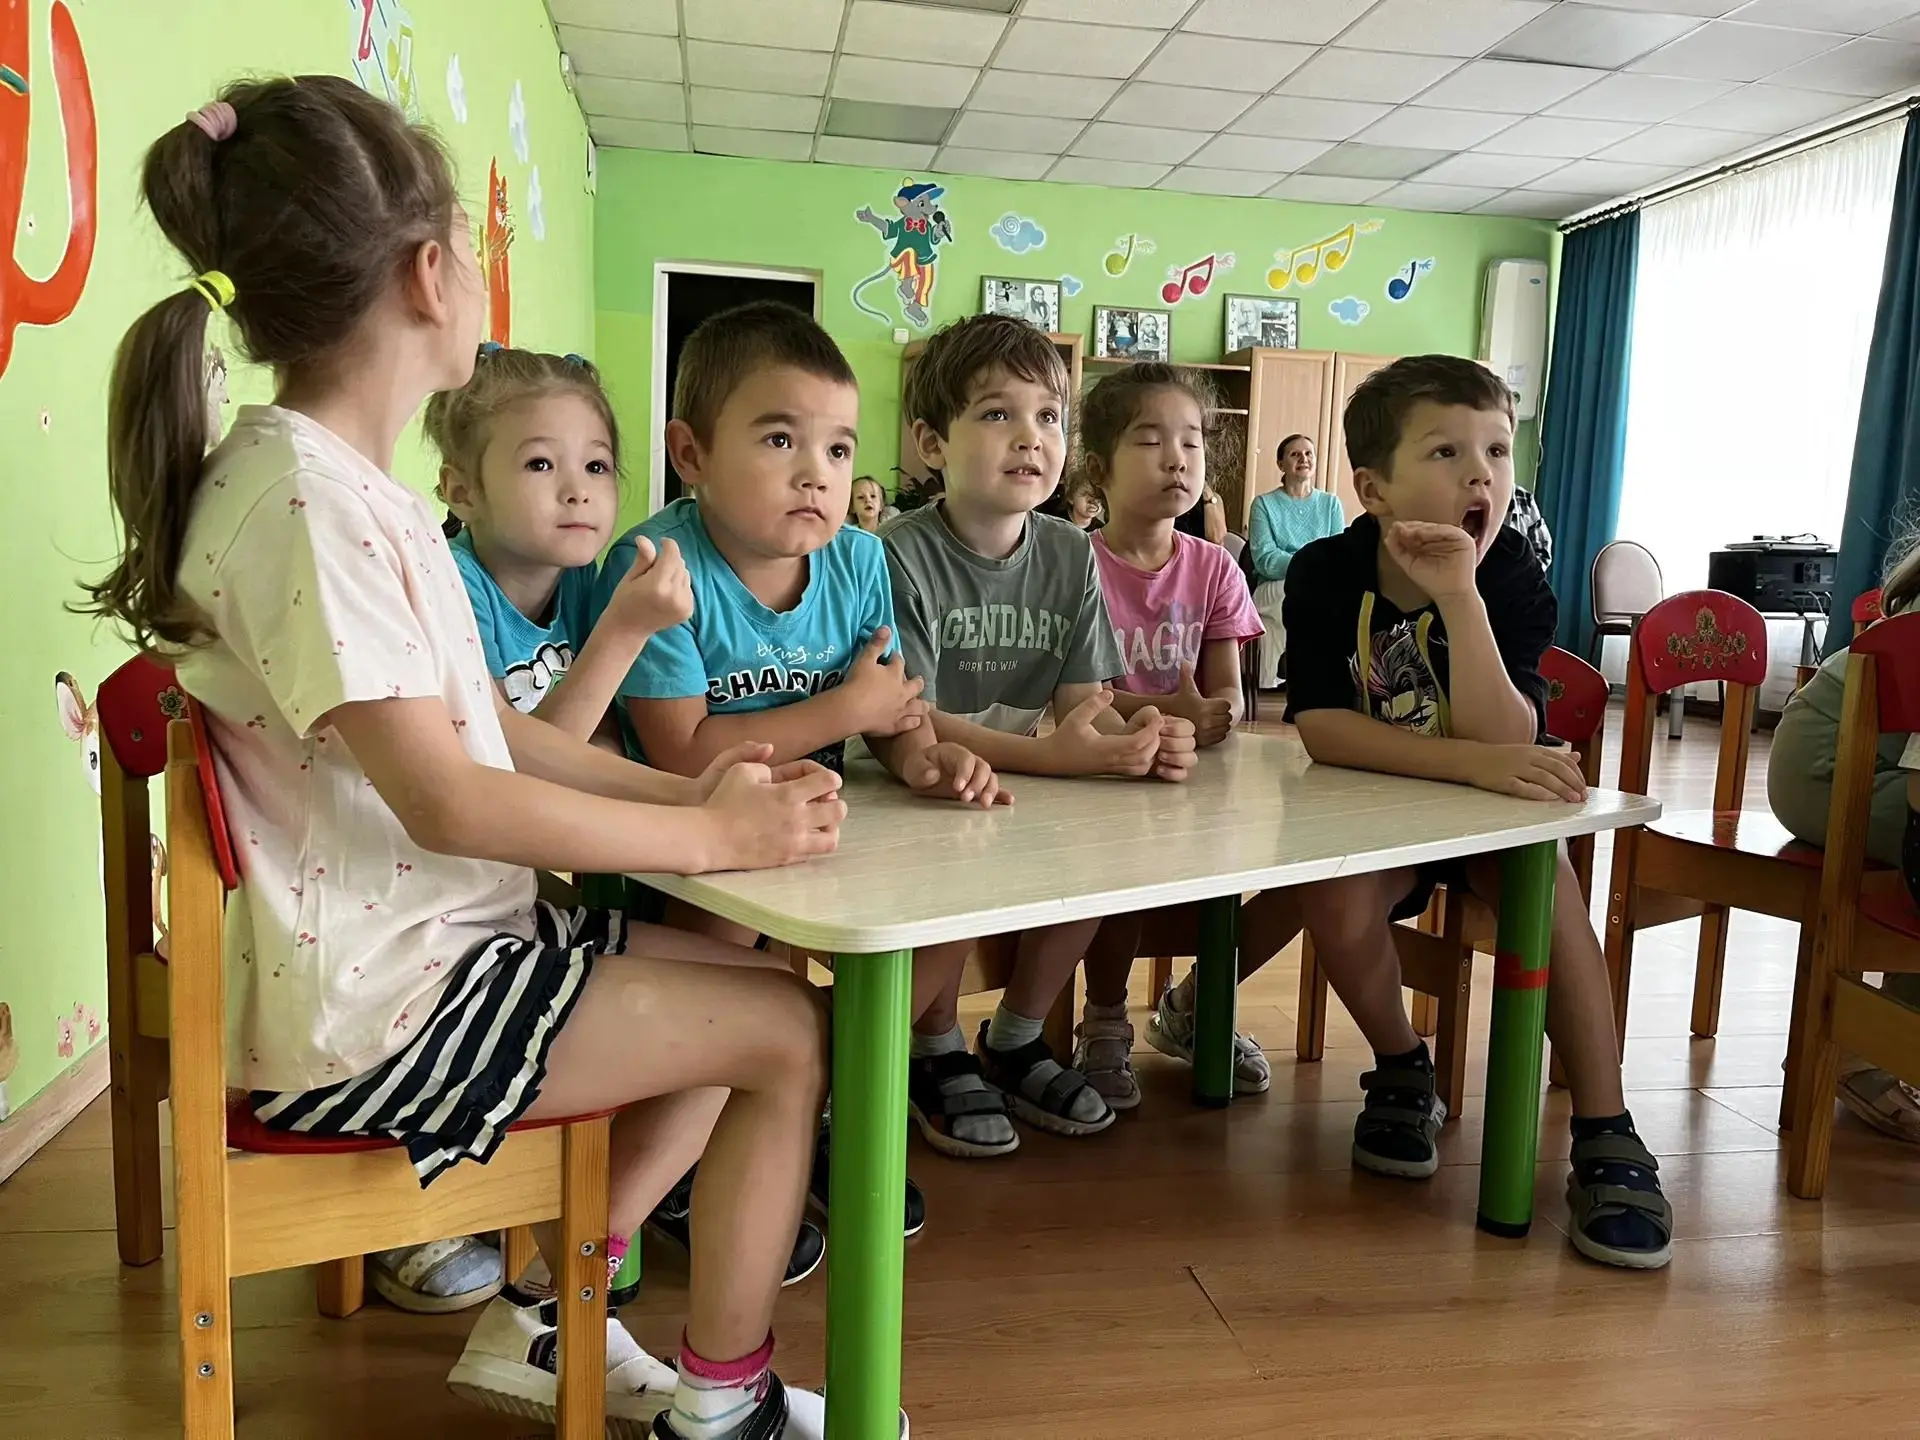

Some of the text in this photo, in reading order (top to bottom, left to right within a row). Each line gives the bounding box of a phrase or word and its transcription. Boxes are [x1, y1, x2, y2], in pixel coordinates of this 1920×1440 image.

[816, 645, 835, 663] of
[958, 660, 1019, 672] BORN TO WIN
